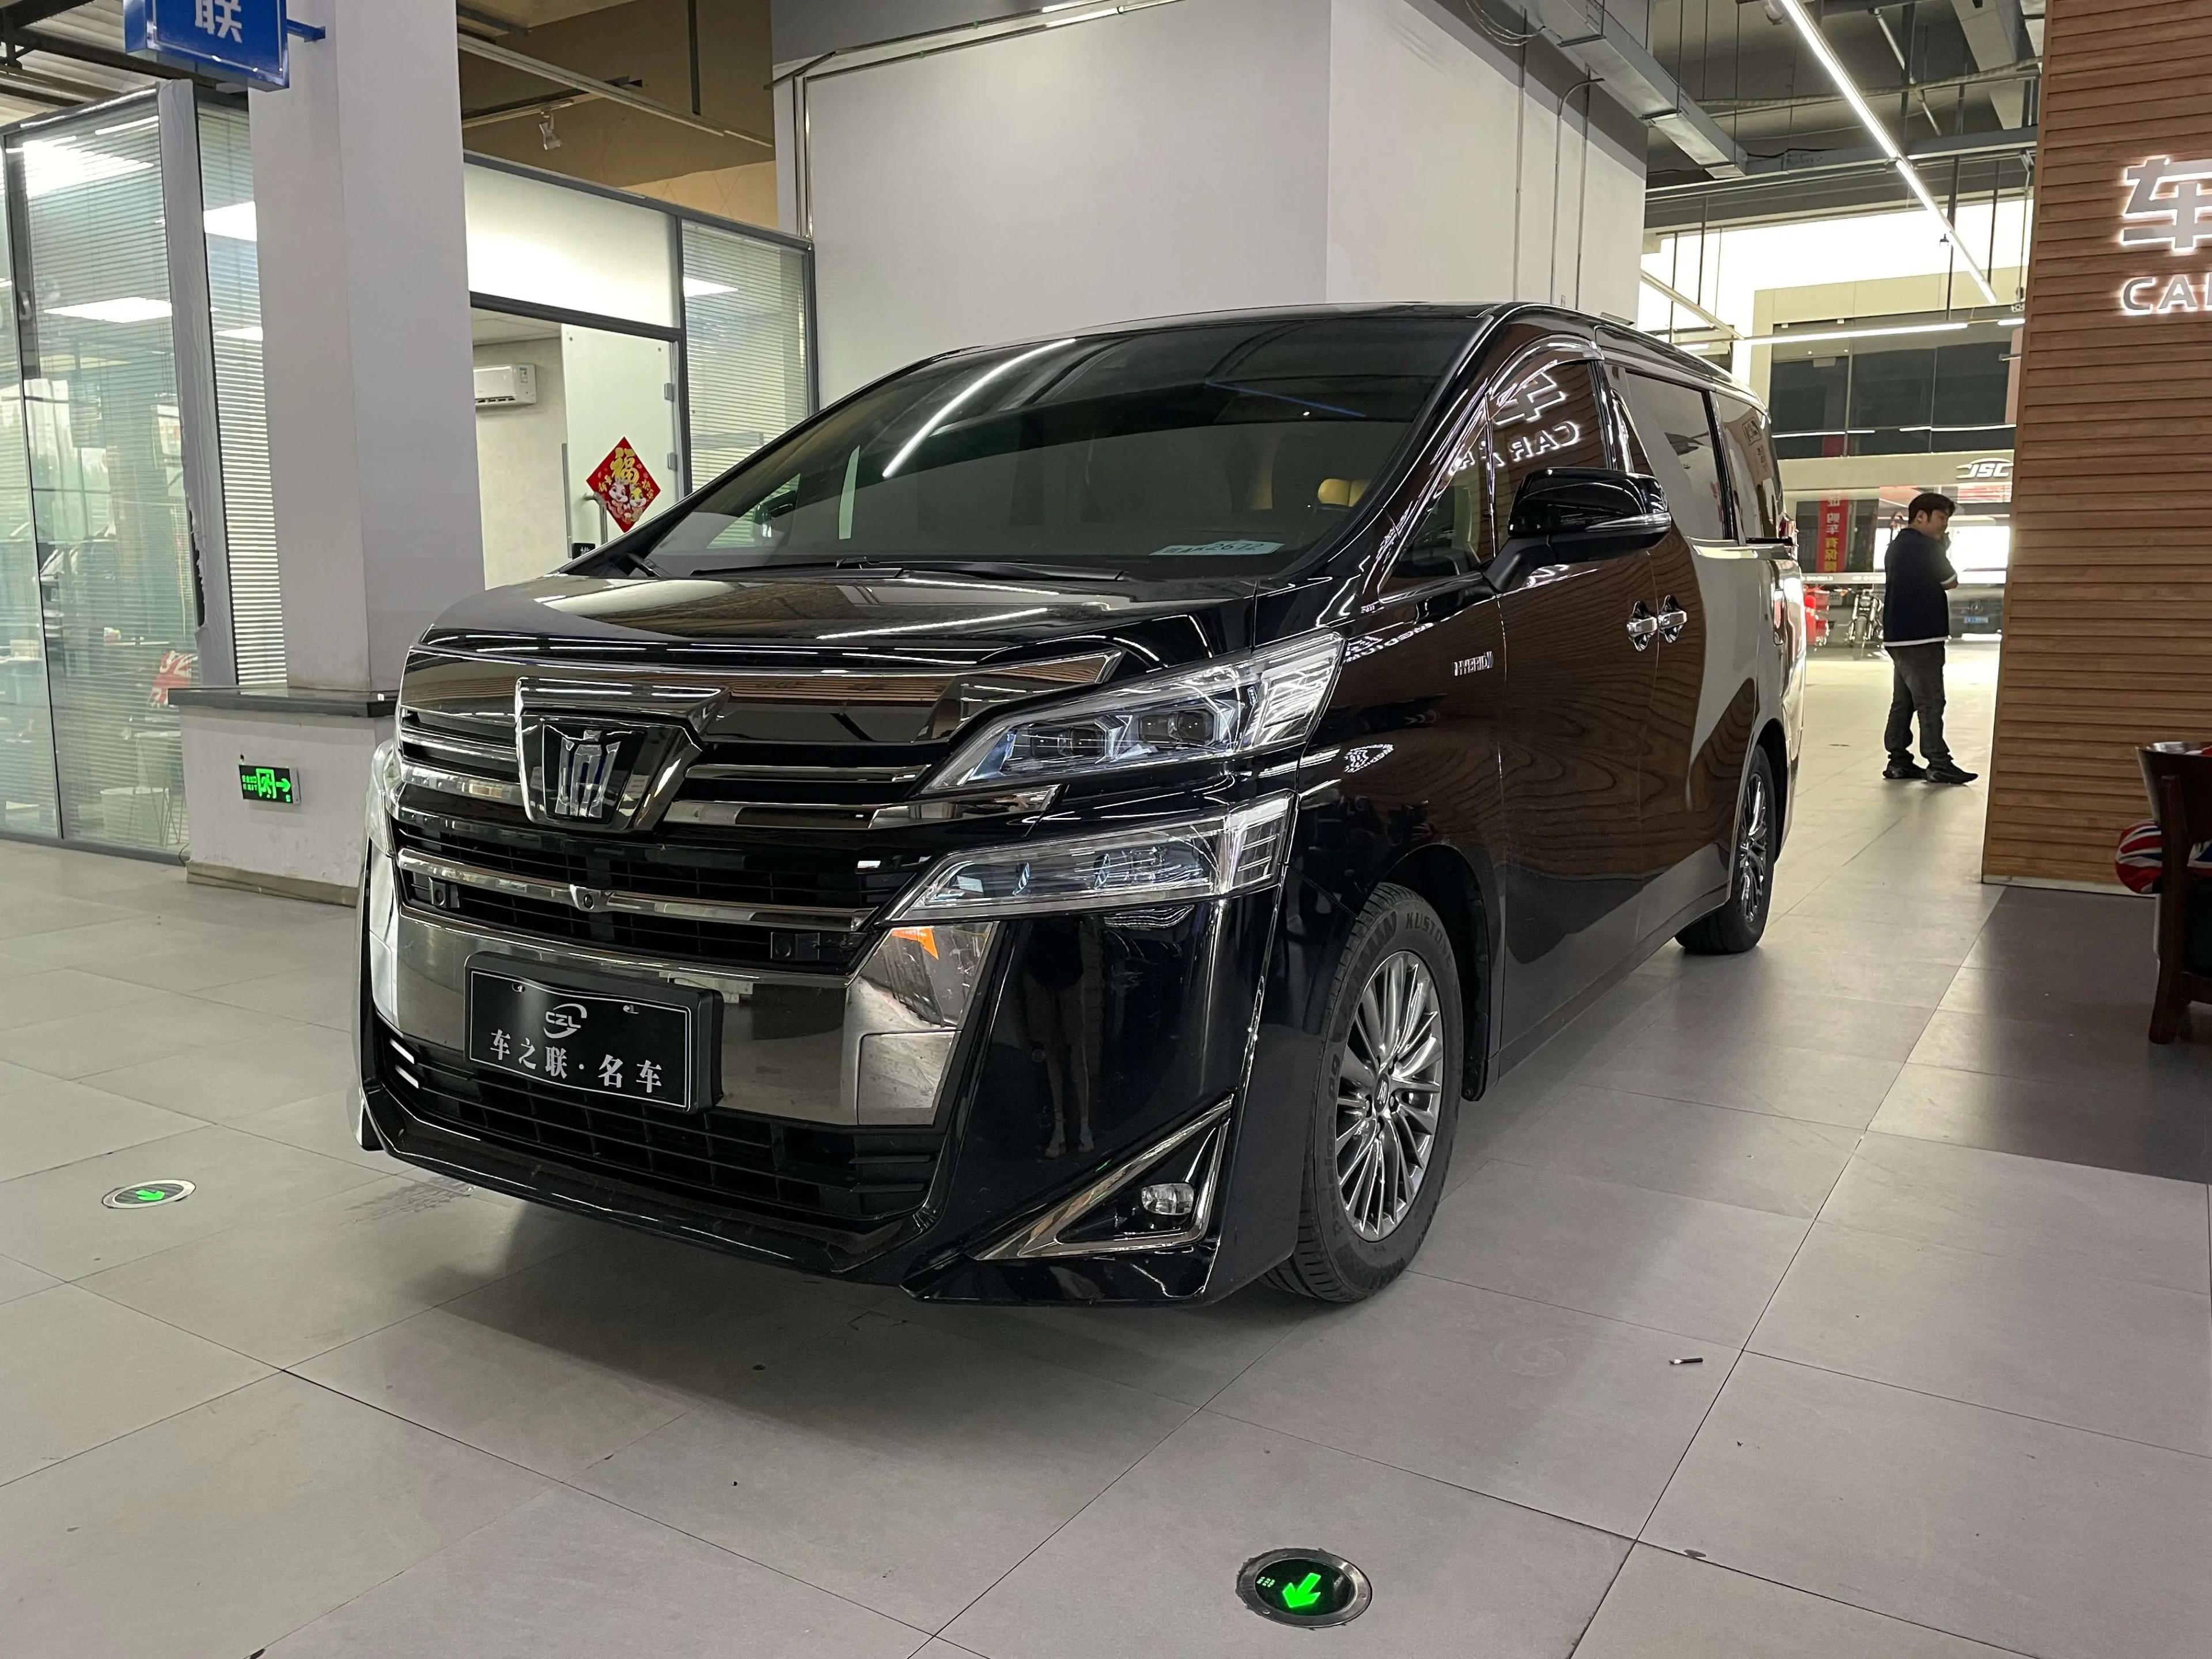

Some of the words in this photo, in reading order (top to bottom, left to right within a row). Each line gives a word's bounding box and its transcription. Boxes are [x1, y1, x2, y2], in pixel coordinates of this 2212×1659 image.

[195, 0, 243, 43] 联
[2122, 274, 2212, 315] CA
[610, 447, 638, 485] 福
[1453, 655, 1488, 676] HYBRID
